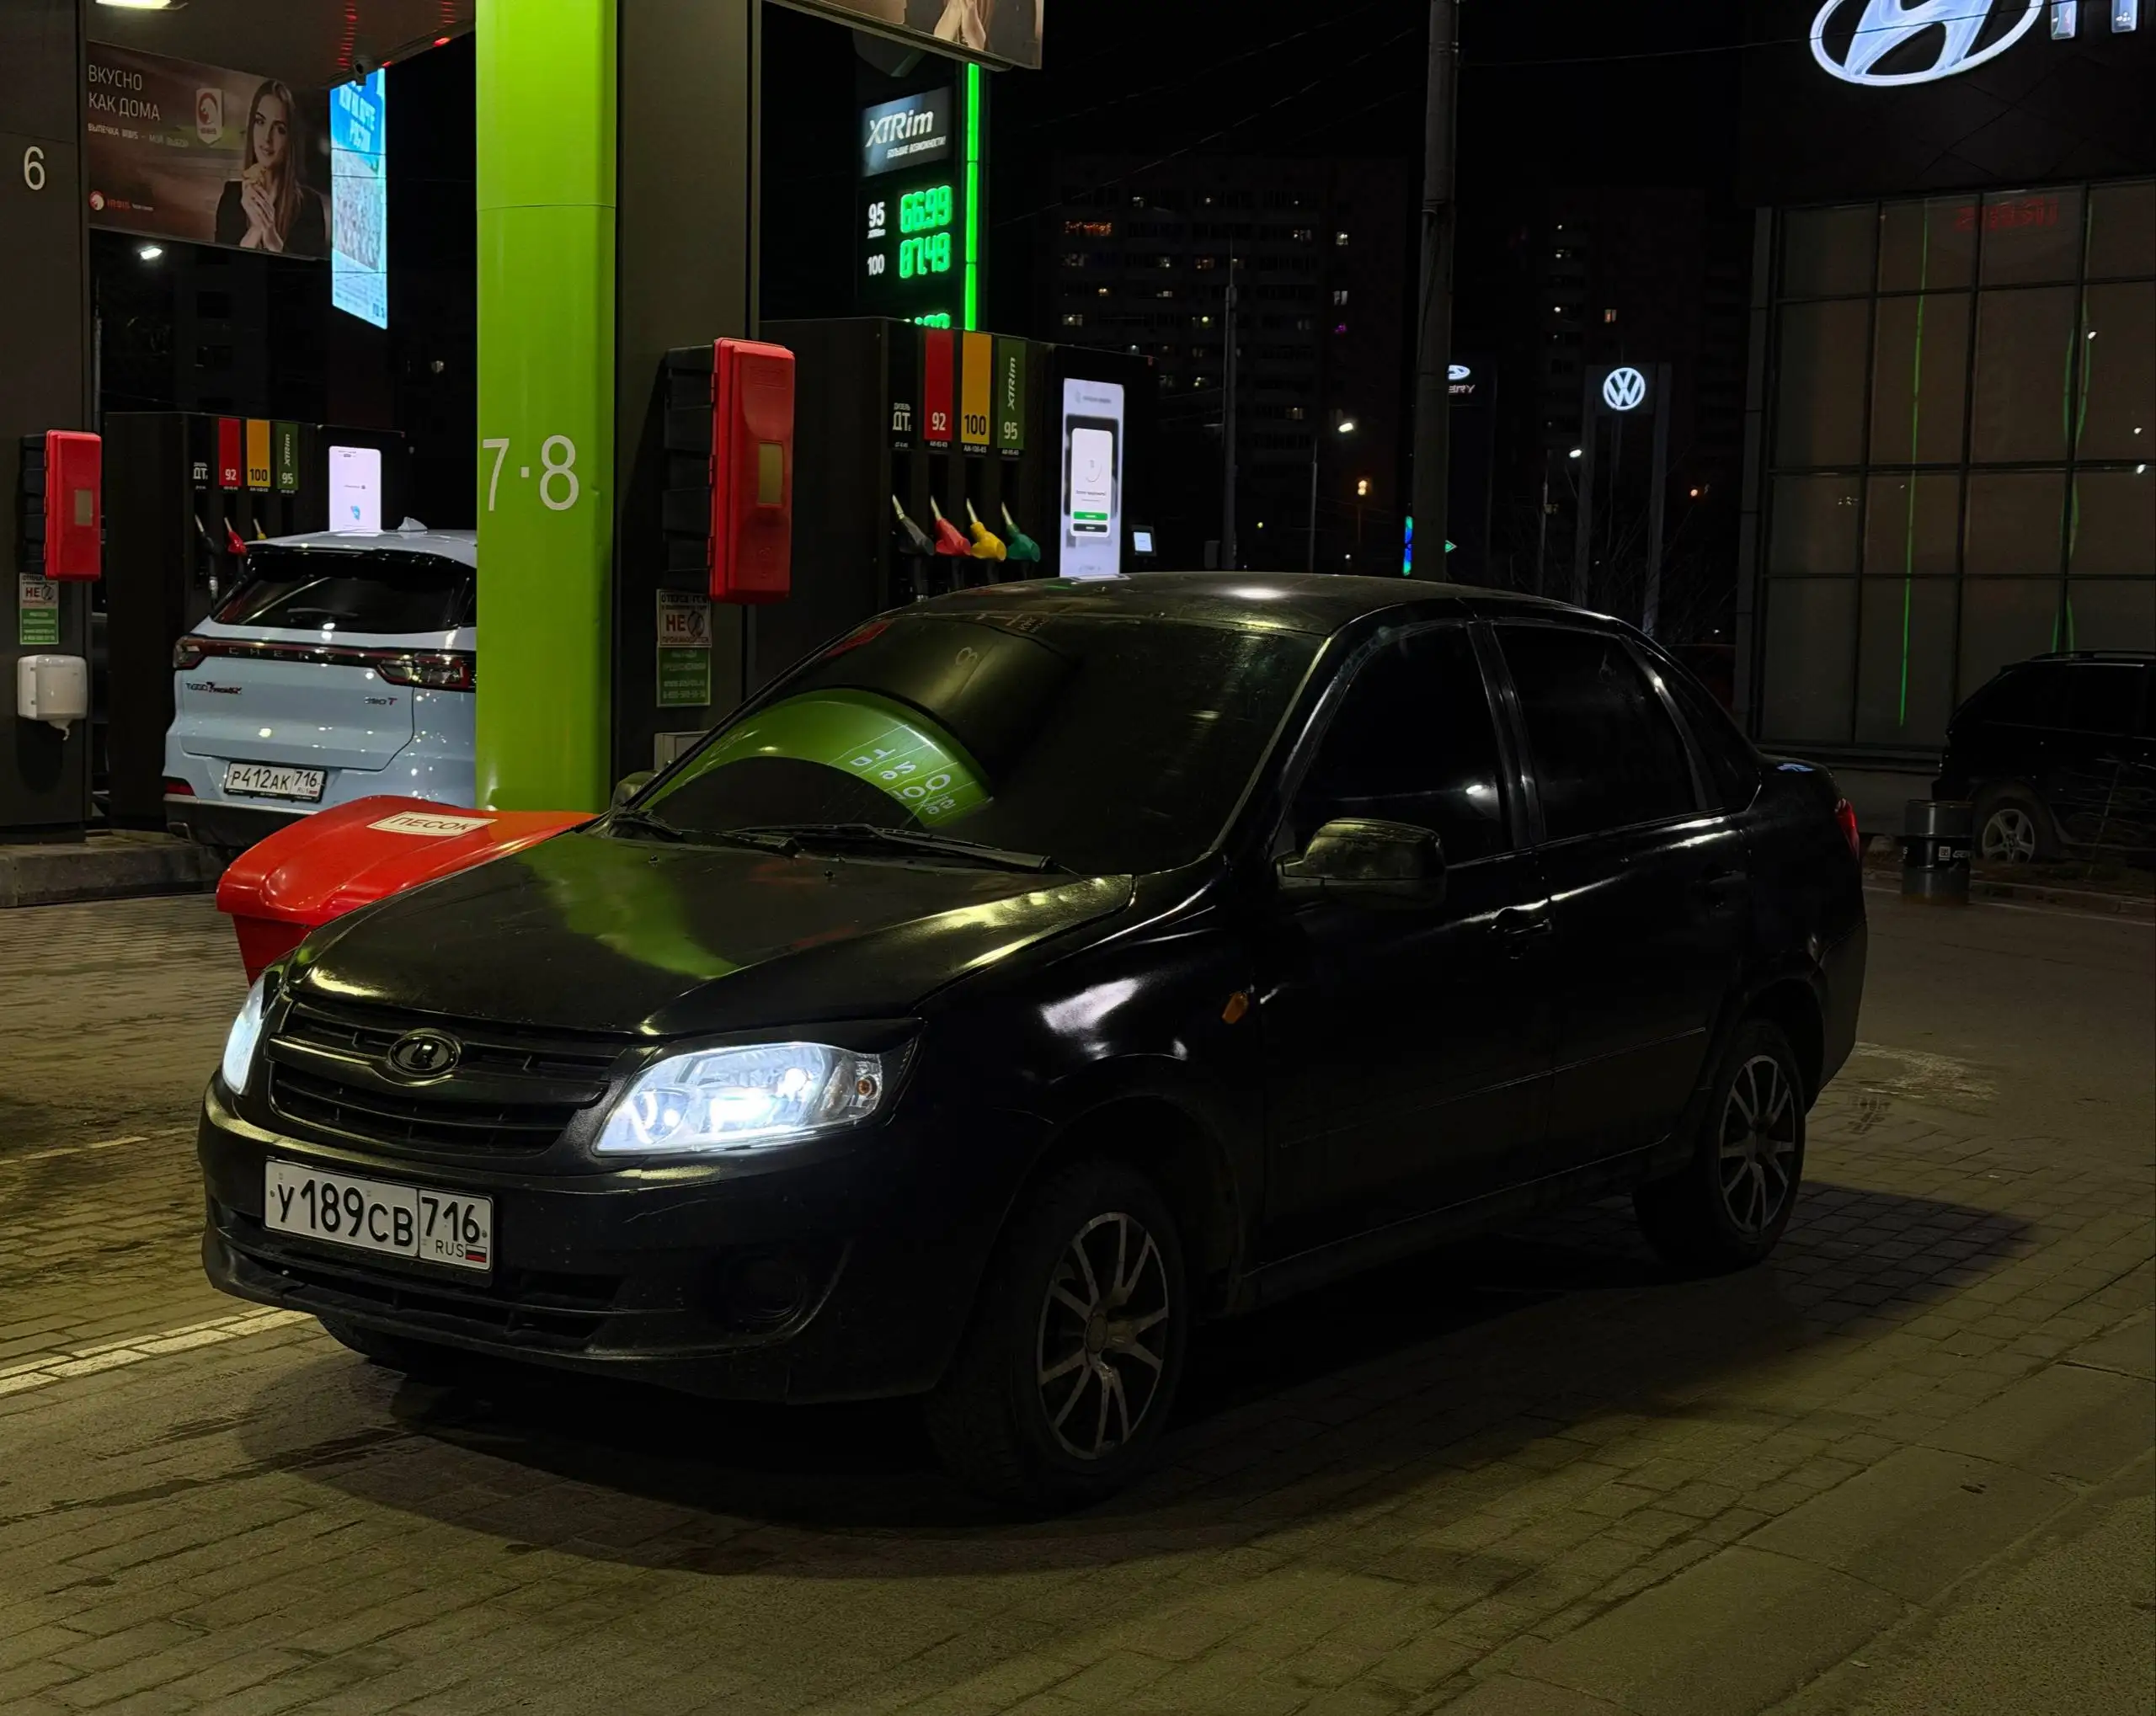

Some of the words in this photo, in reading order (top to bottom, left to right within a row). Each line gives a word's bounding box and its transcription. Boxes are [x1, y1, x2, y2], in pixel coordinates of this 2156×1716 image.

[88, 65, 142, 90] ВКУСНО
[88, 93, 116, 113] КАК
[119, 98, 161, 121] ДОМА
[865, 109, 934, 147] XTRim
[23, 147, 45, 189] 6
[868, 201, 885, 227] 95
[867, 253, 885, 276] 100
[931, 412, 946, 430] 92
[964, 414, 986, 435] 100
[1004, 421, 1017, 440] 95
[225, 469, 236, 481] 92
[249, 469, 268, 482] 100
[281, 472, 293, 484] 95
[26, 587, 40, 598] НЕ
[665, 614, 685, 632] НЕ
[229, 647, 336, 661] CHERY
[230, 769, 291, 791] Р412АК
[294, 770, 318, 787] 716
[390, 817, 476, 830] ПЕСОК
[278, 1179, 413, 1246] У189СВ
[422, 1196, 480, 1244] 716
[435, 1240, 464, 1257] RUS
